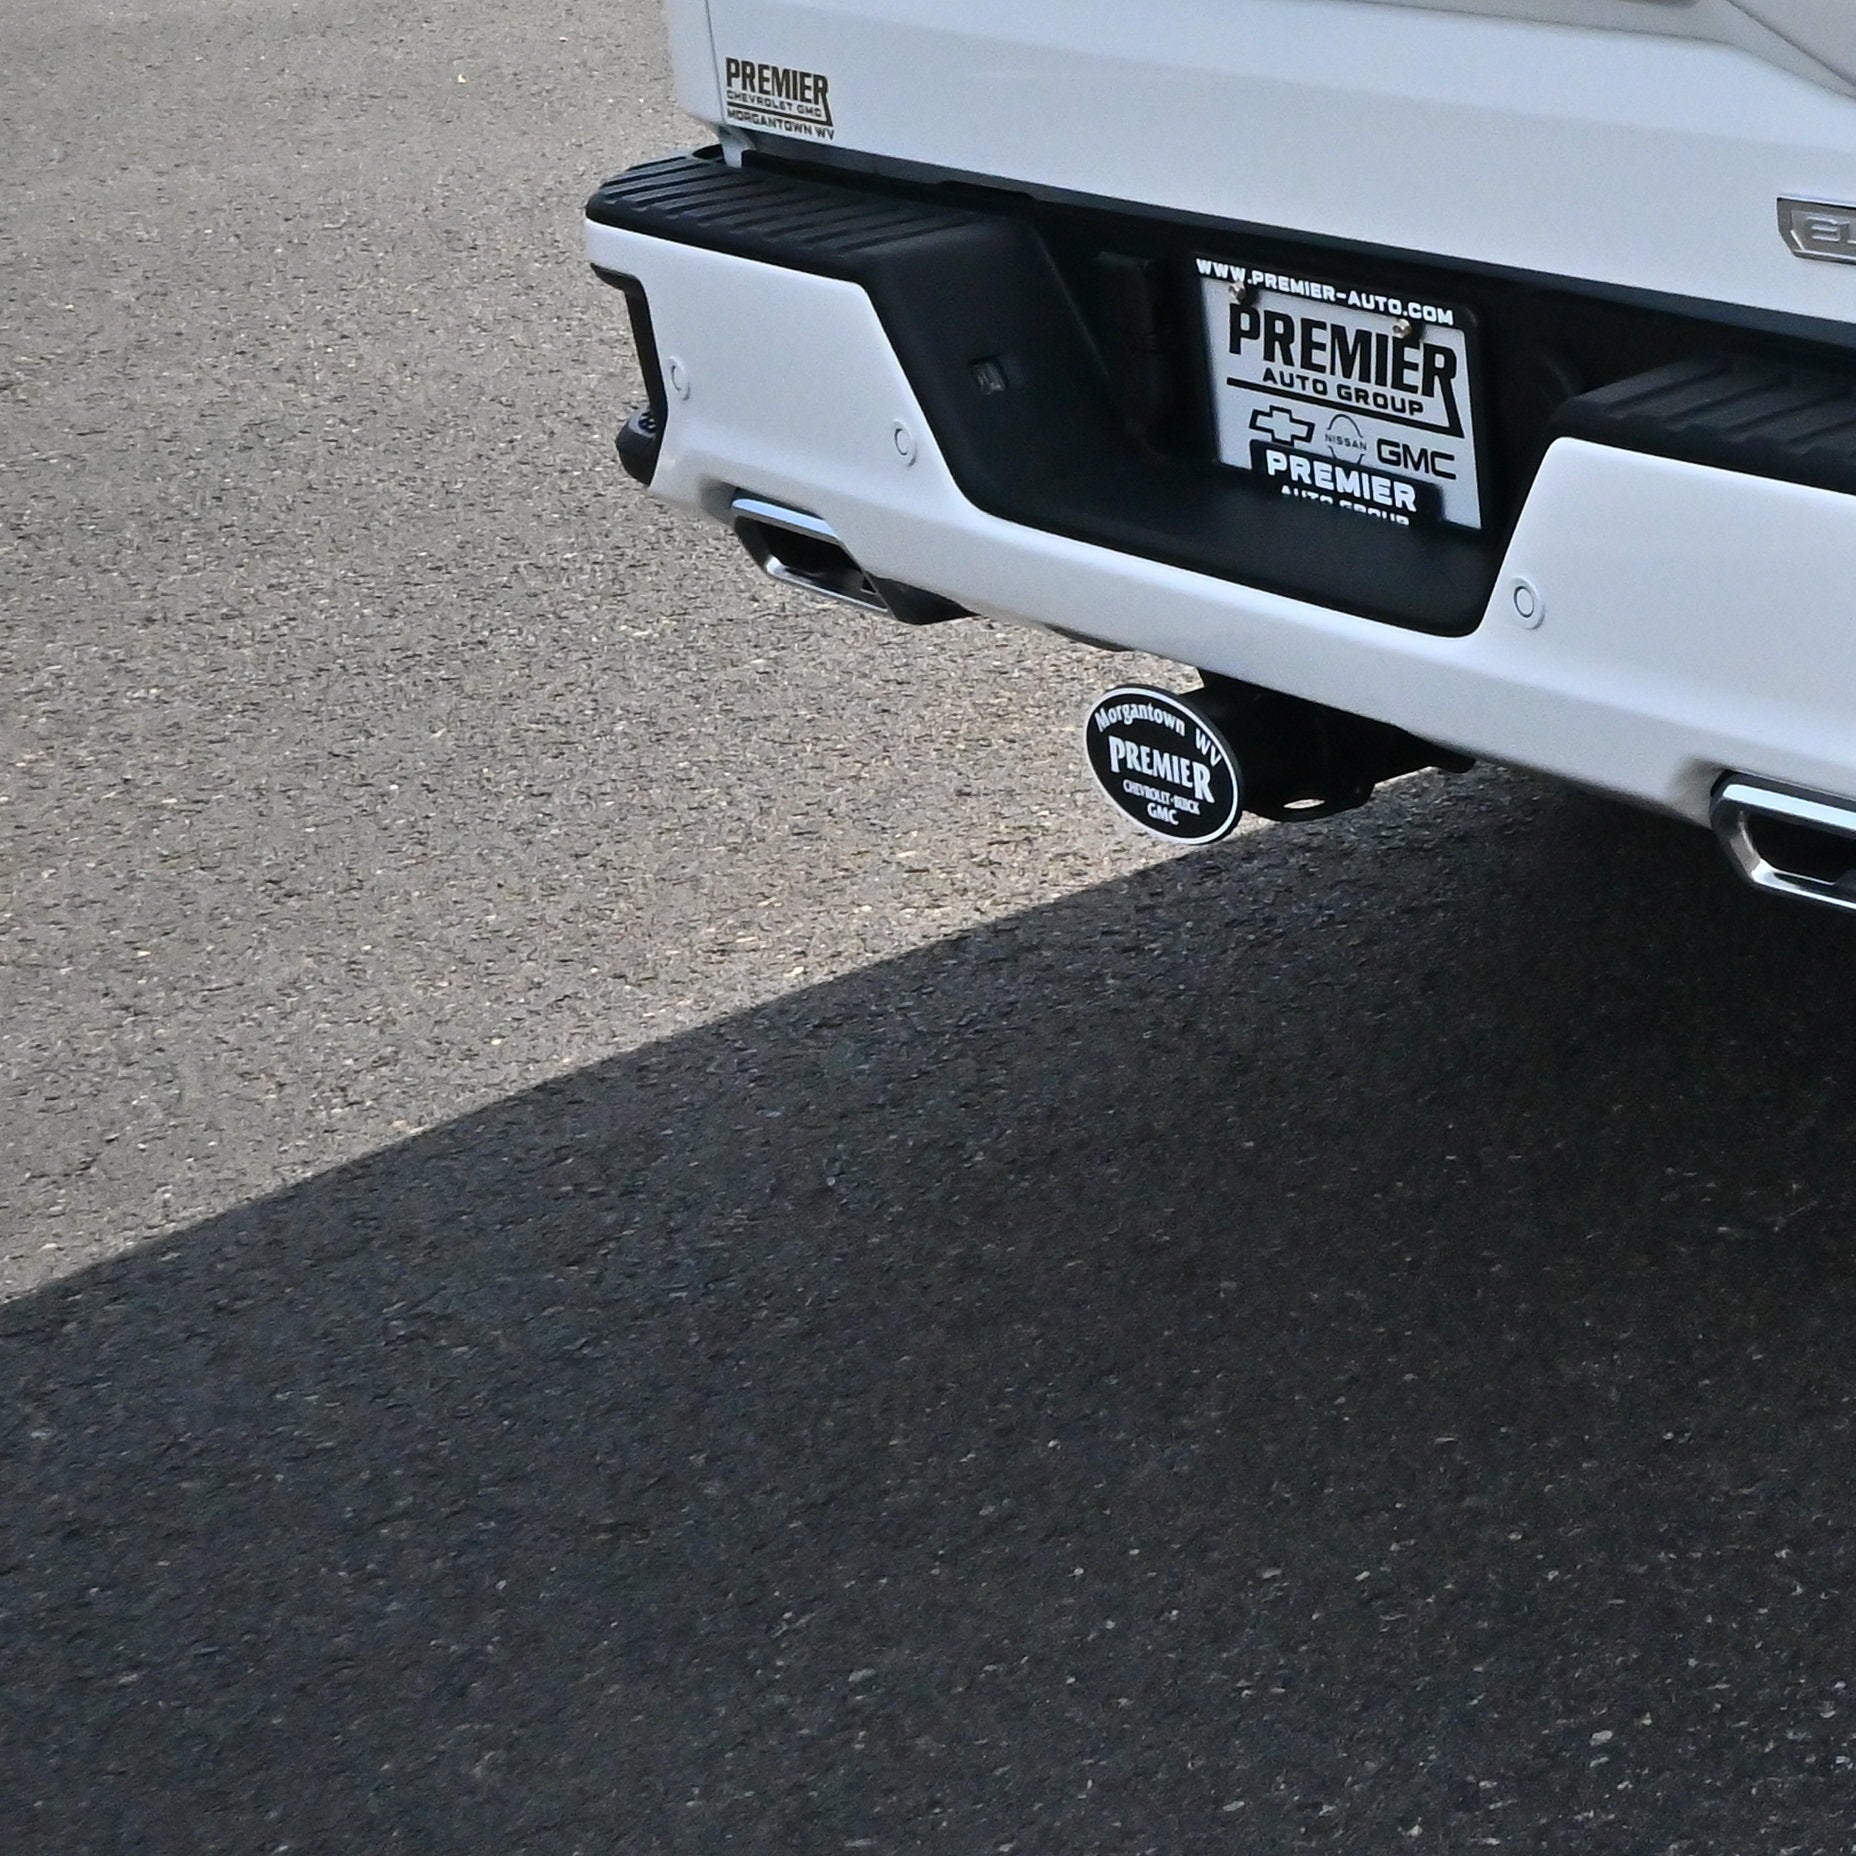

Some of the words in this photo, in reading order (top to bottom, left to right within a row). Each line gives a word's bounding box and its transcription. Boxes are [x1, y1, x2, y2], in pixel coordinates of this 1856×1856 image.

[726, 57, 830, 107] PREMIER
[726, 90, 793, 111] CHEVROLET
[796, 105, 822, 118] GMC
[727, 108, 813, 135] MORGANTOWN
[815, 128, 835, 141] WV
[1196, 258, 1454, 326] WWW.PREMIER-AUTO.COM
[1228, 302, 1458, 400] PREMIER
[1262, 367, 1328, 397] AUTO
[1336, 384, 1424, 416] GROUP
[1266, 449, 1417, 513] PREMIER
[1325, 433, 1367, 451] NISSAN
[1376, 438, 1457, 481] GMC
[1094, 703, 1186, 737] Morgantown
[1195, 728, 1222, 767] WV
[1108, 735, 1215, 804] PREMIER
[1147, 802, 1179, 826] GMC
